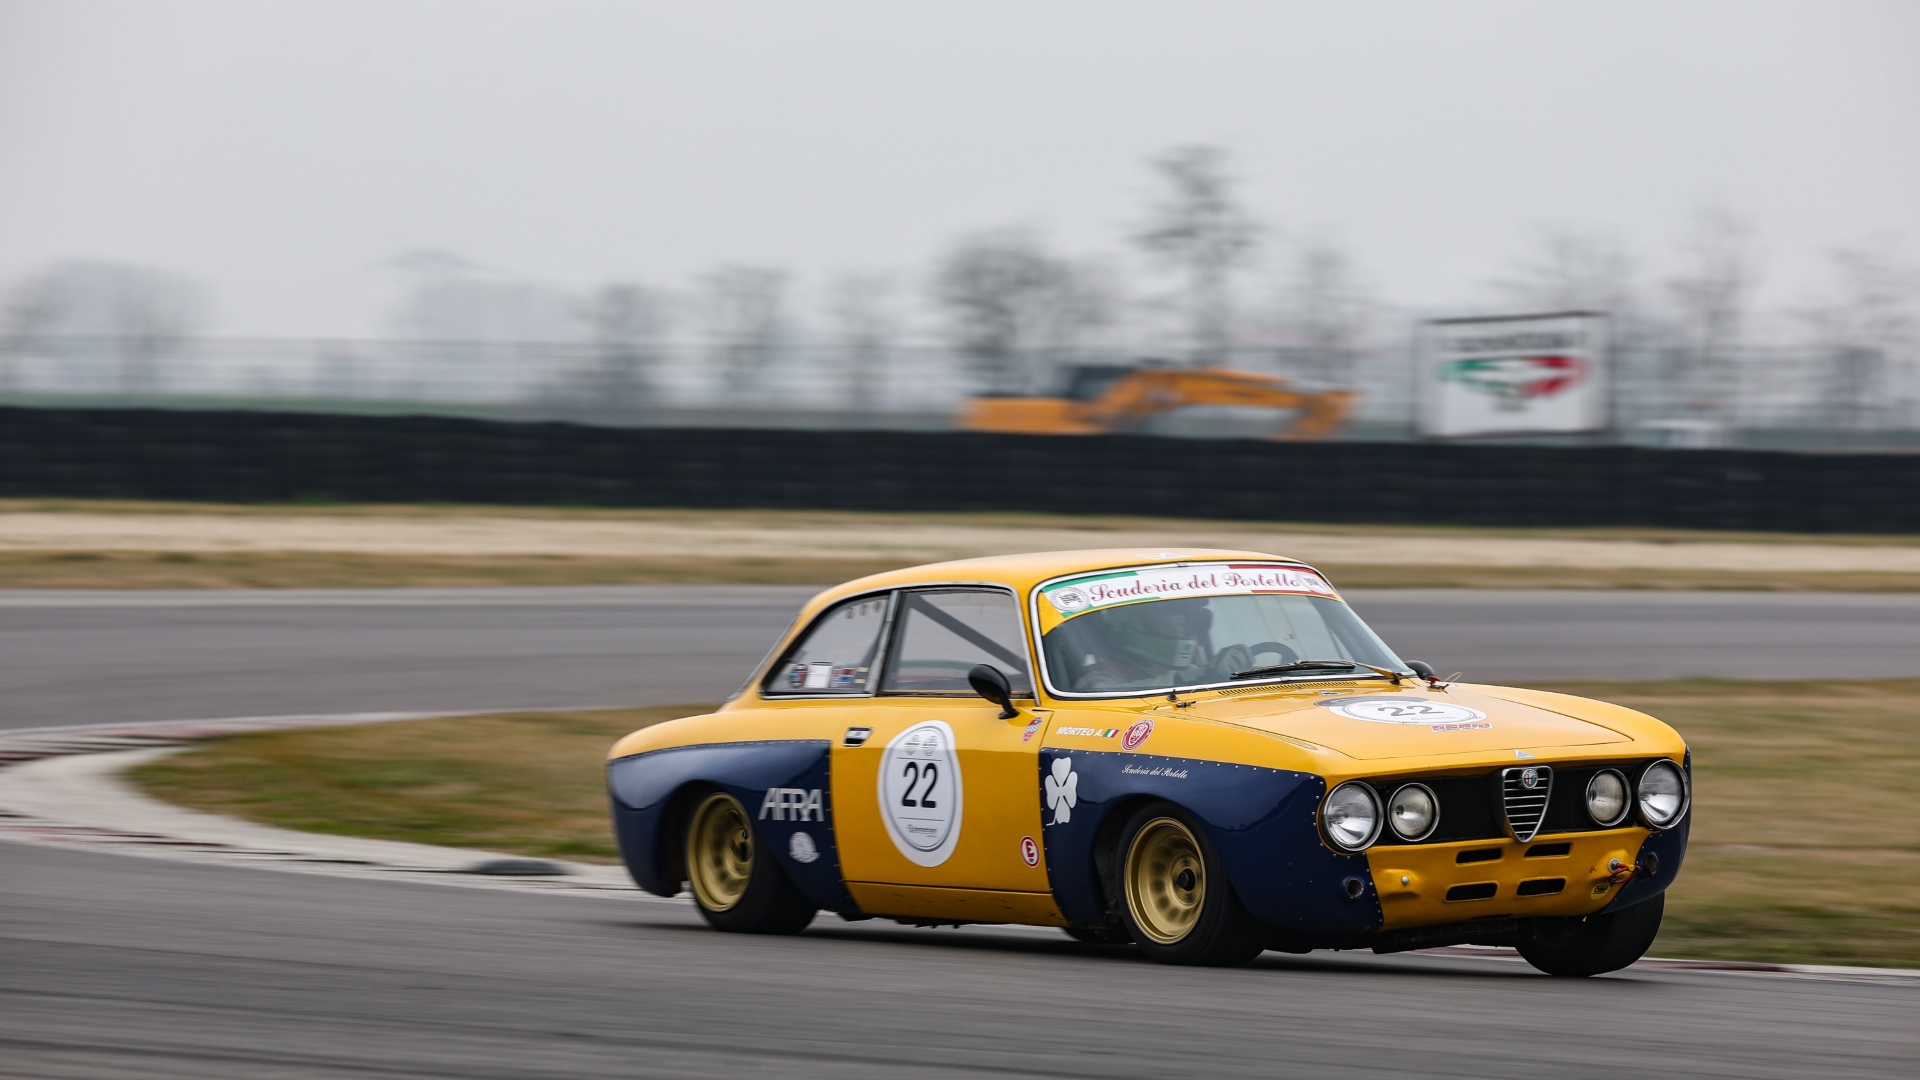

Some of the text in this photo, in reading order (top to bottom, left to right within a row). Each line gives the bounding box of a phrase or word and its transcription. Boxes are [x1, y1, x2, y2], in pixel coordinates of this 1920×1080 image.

[1089, 579, 1184, 602] Scuderia
[1187, 573, 1220, 589] del
[1222, 572, 1301, 588] Portello
[1377, 705, 1445, 717] 22
[1055, 726, 1095, 736] MORTEO
[1121, 763, 1189, 779] Scuderia del Portello
[901, 761, 939, 809] 22
[758, 787, 825, 822] AFRA
[1025, 840, 1035, 858] E
